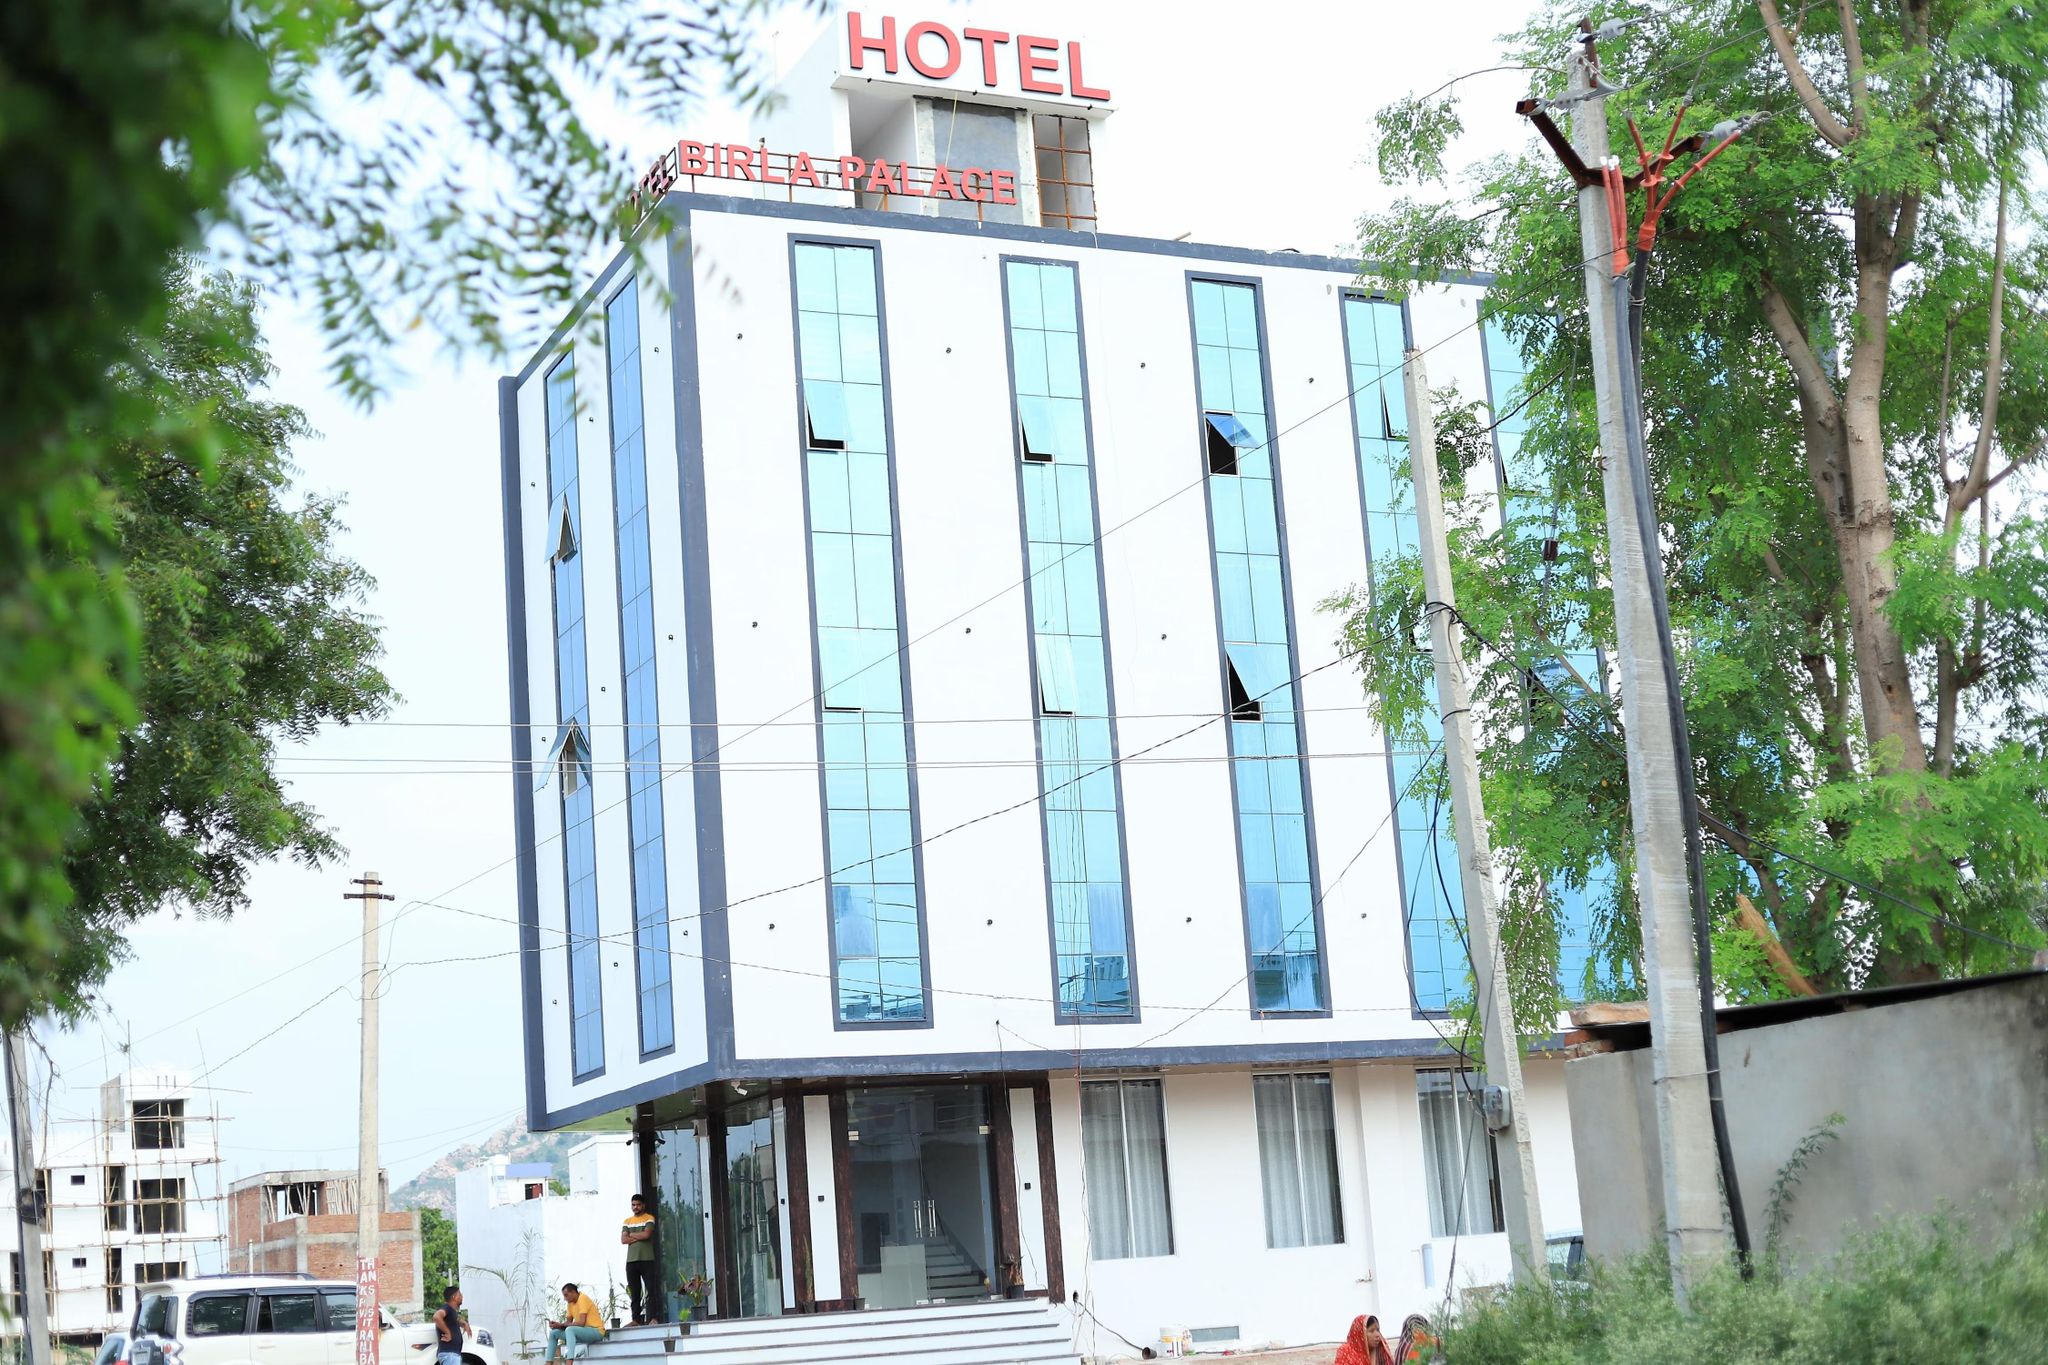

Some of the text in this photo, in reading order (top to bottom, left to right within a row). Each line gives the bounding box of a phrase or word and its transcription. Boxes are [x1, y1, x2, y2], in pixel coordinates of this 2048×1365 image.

[848, 11, 1110, 101] HOTEL
[678, 140, 1016, 205] BIRLA PALACE
